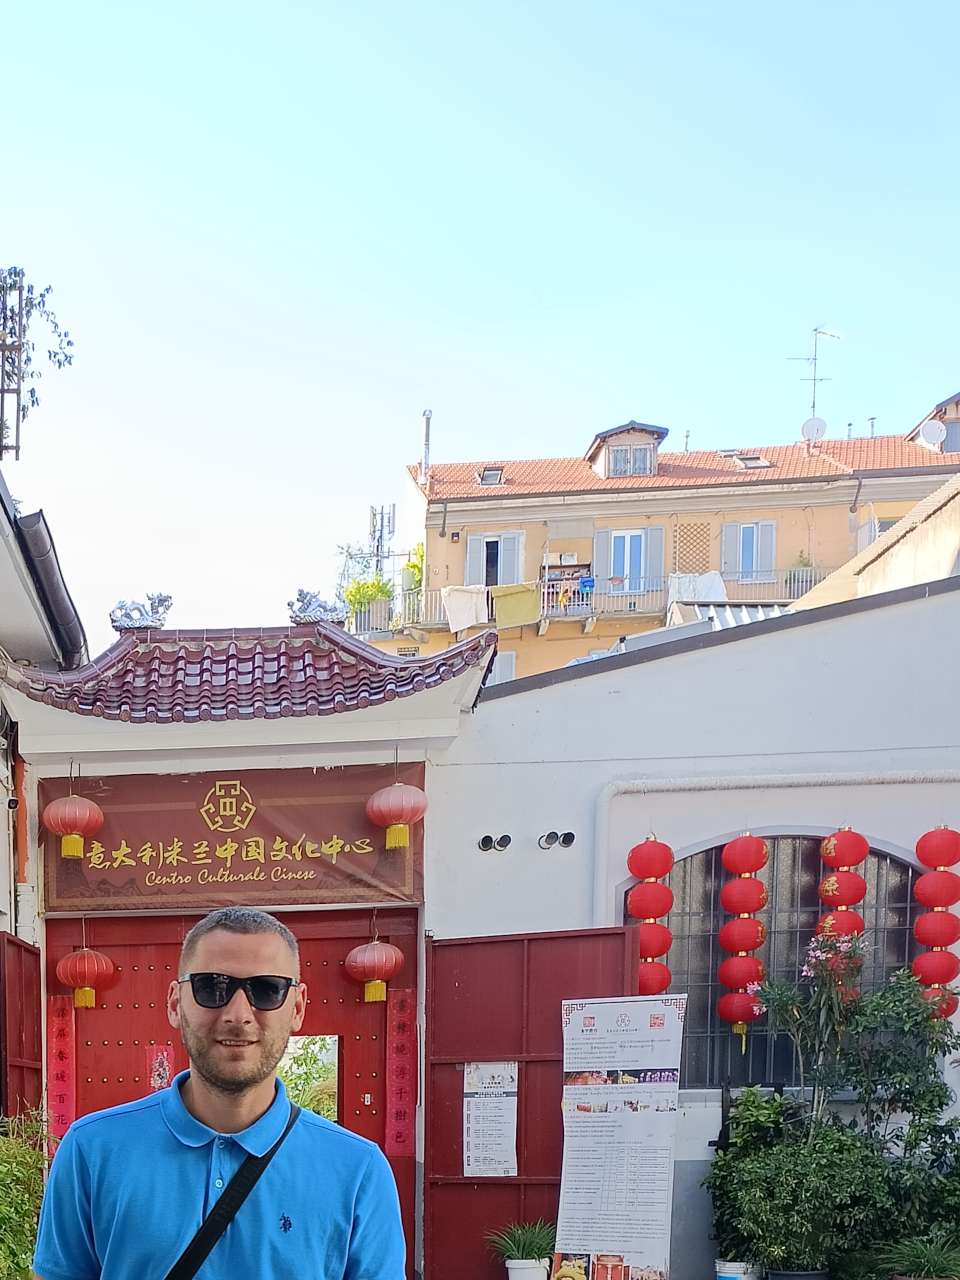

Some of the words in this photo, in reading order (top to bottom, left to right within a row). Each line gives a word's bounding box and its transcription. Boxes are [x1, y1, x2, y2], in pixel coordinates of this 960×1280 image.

[86, 833, 374, 870] 意大利米兰中国文化中心
[145, 871, 192, 887] Centro
[198, 866, 266, 885] Culturale
[271, 866, 317, 881] Cinese
